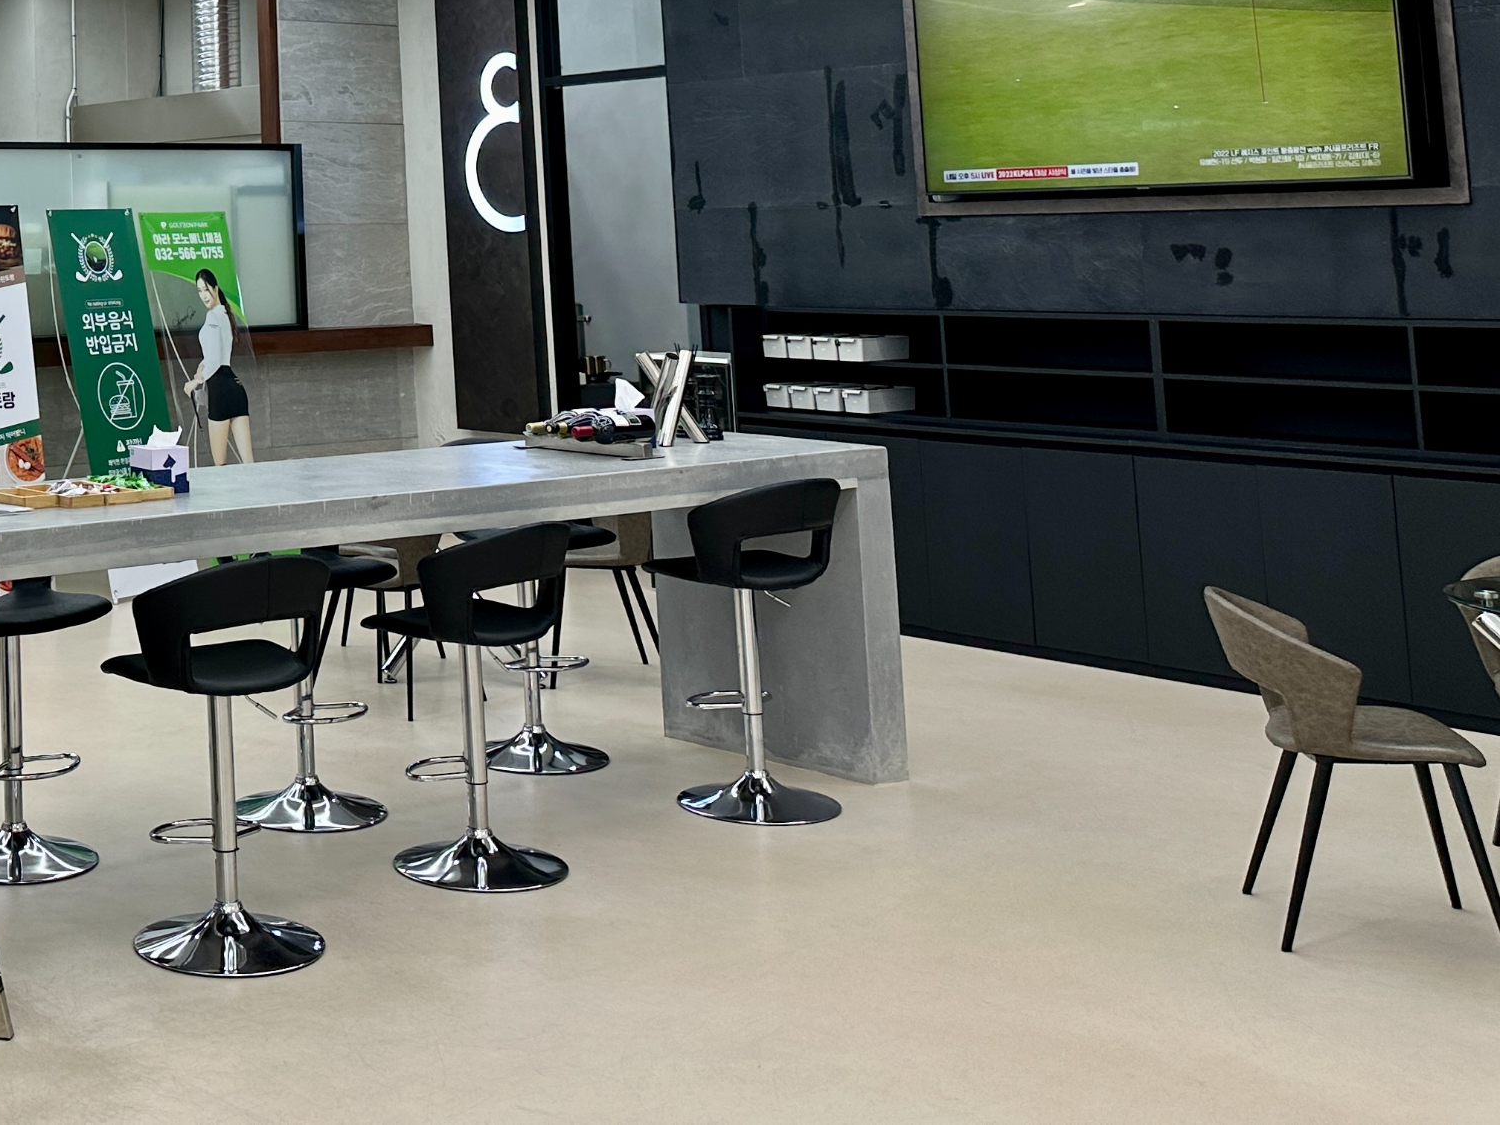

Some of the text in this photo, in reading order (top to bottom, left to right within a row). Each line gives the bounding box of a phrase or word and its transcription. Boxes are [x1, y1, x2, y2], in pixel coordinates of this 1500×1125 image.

[1212, 150, 1230, 158] 2022
[981, 171, 995, 179] LIVE
[153, 233, 171, 245] 아라
[154, 246, 224, 261] 032-566-0755
[81, 310, 134, 332] 외부음식
[85, 332, 138, 355] 반입금지
